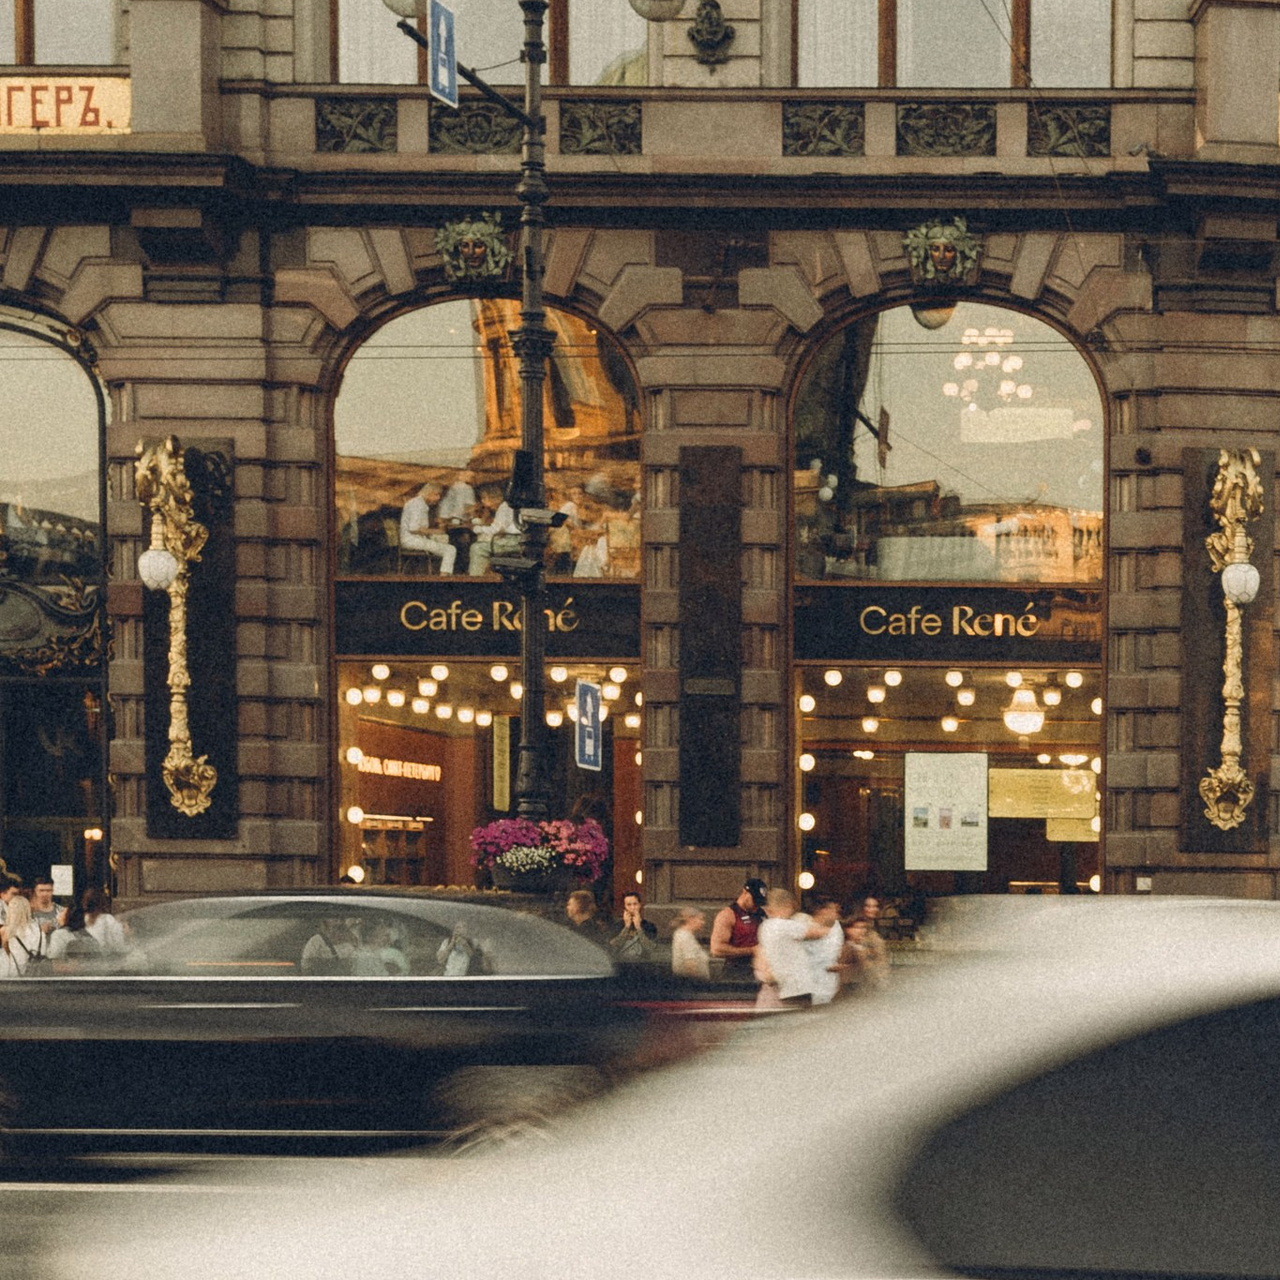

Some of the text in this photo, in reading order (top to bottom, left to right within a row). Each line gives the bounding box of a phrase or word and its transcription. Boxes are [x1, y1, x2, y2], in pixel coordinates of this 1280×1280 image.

[0, 85, 112, 128] ГЕРЪ.
[400, 600, 483, 631] Cafe
[860, 602, 1041, 637] Cafe René
